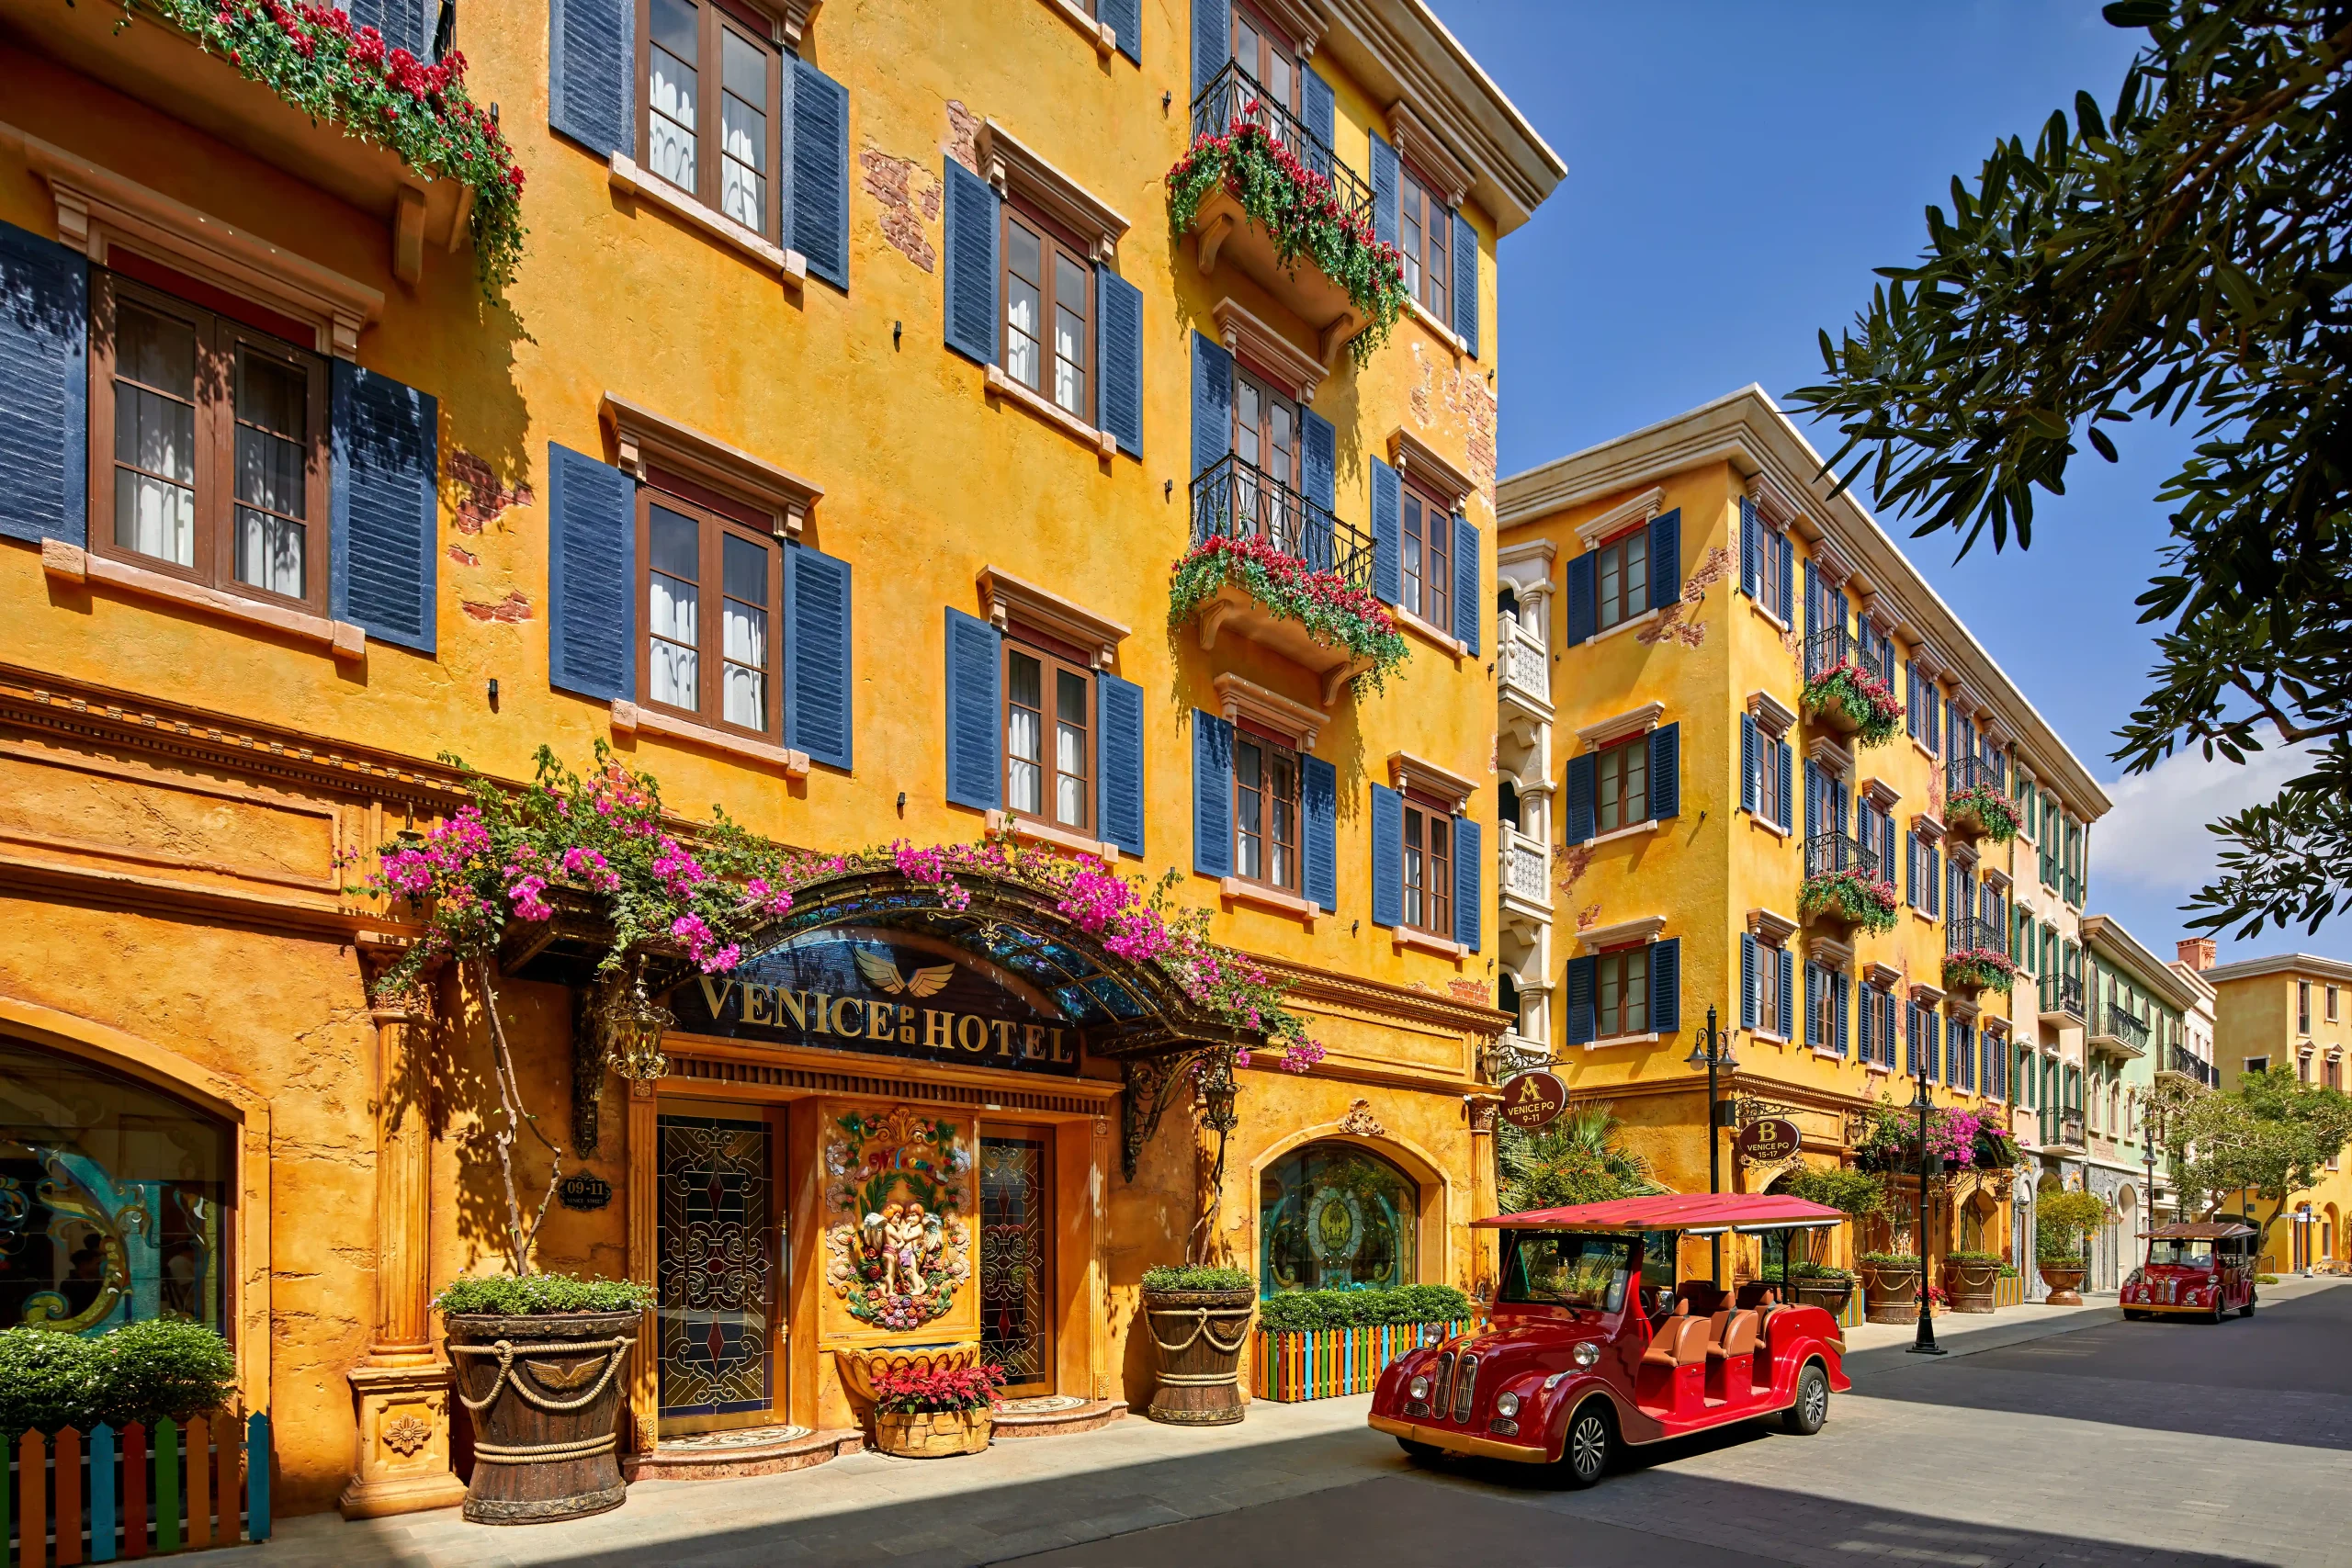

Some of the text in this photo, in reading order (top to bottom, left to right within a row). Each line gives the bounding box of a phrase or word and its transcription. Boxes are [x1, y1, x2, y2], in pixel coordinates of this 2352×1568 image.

[697, 976, 894, 1042] VENICE
[922, 1009, 1074, 1064] HOTEL
[1518, 1076, 1544, 1103] A
[1508, 1100, 1555, 1116] VENICE PQ
[1522, 1114, 1540, 1122] 9-11
[1758, 1122, 1777, 1143] B
[1747, 1143, 1776, 1151] VENICE
